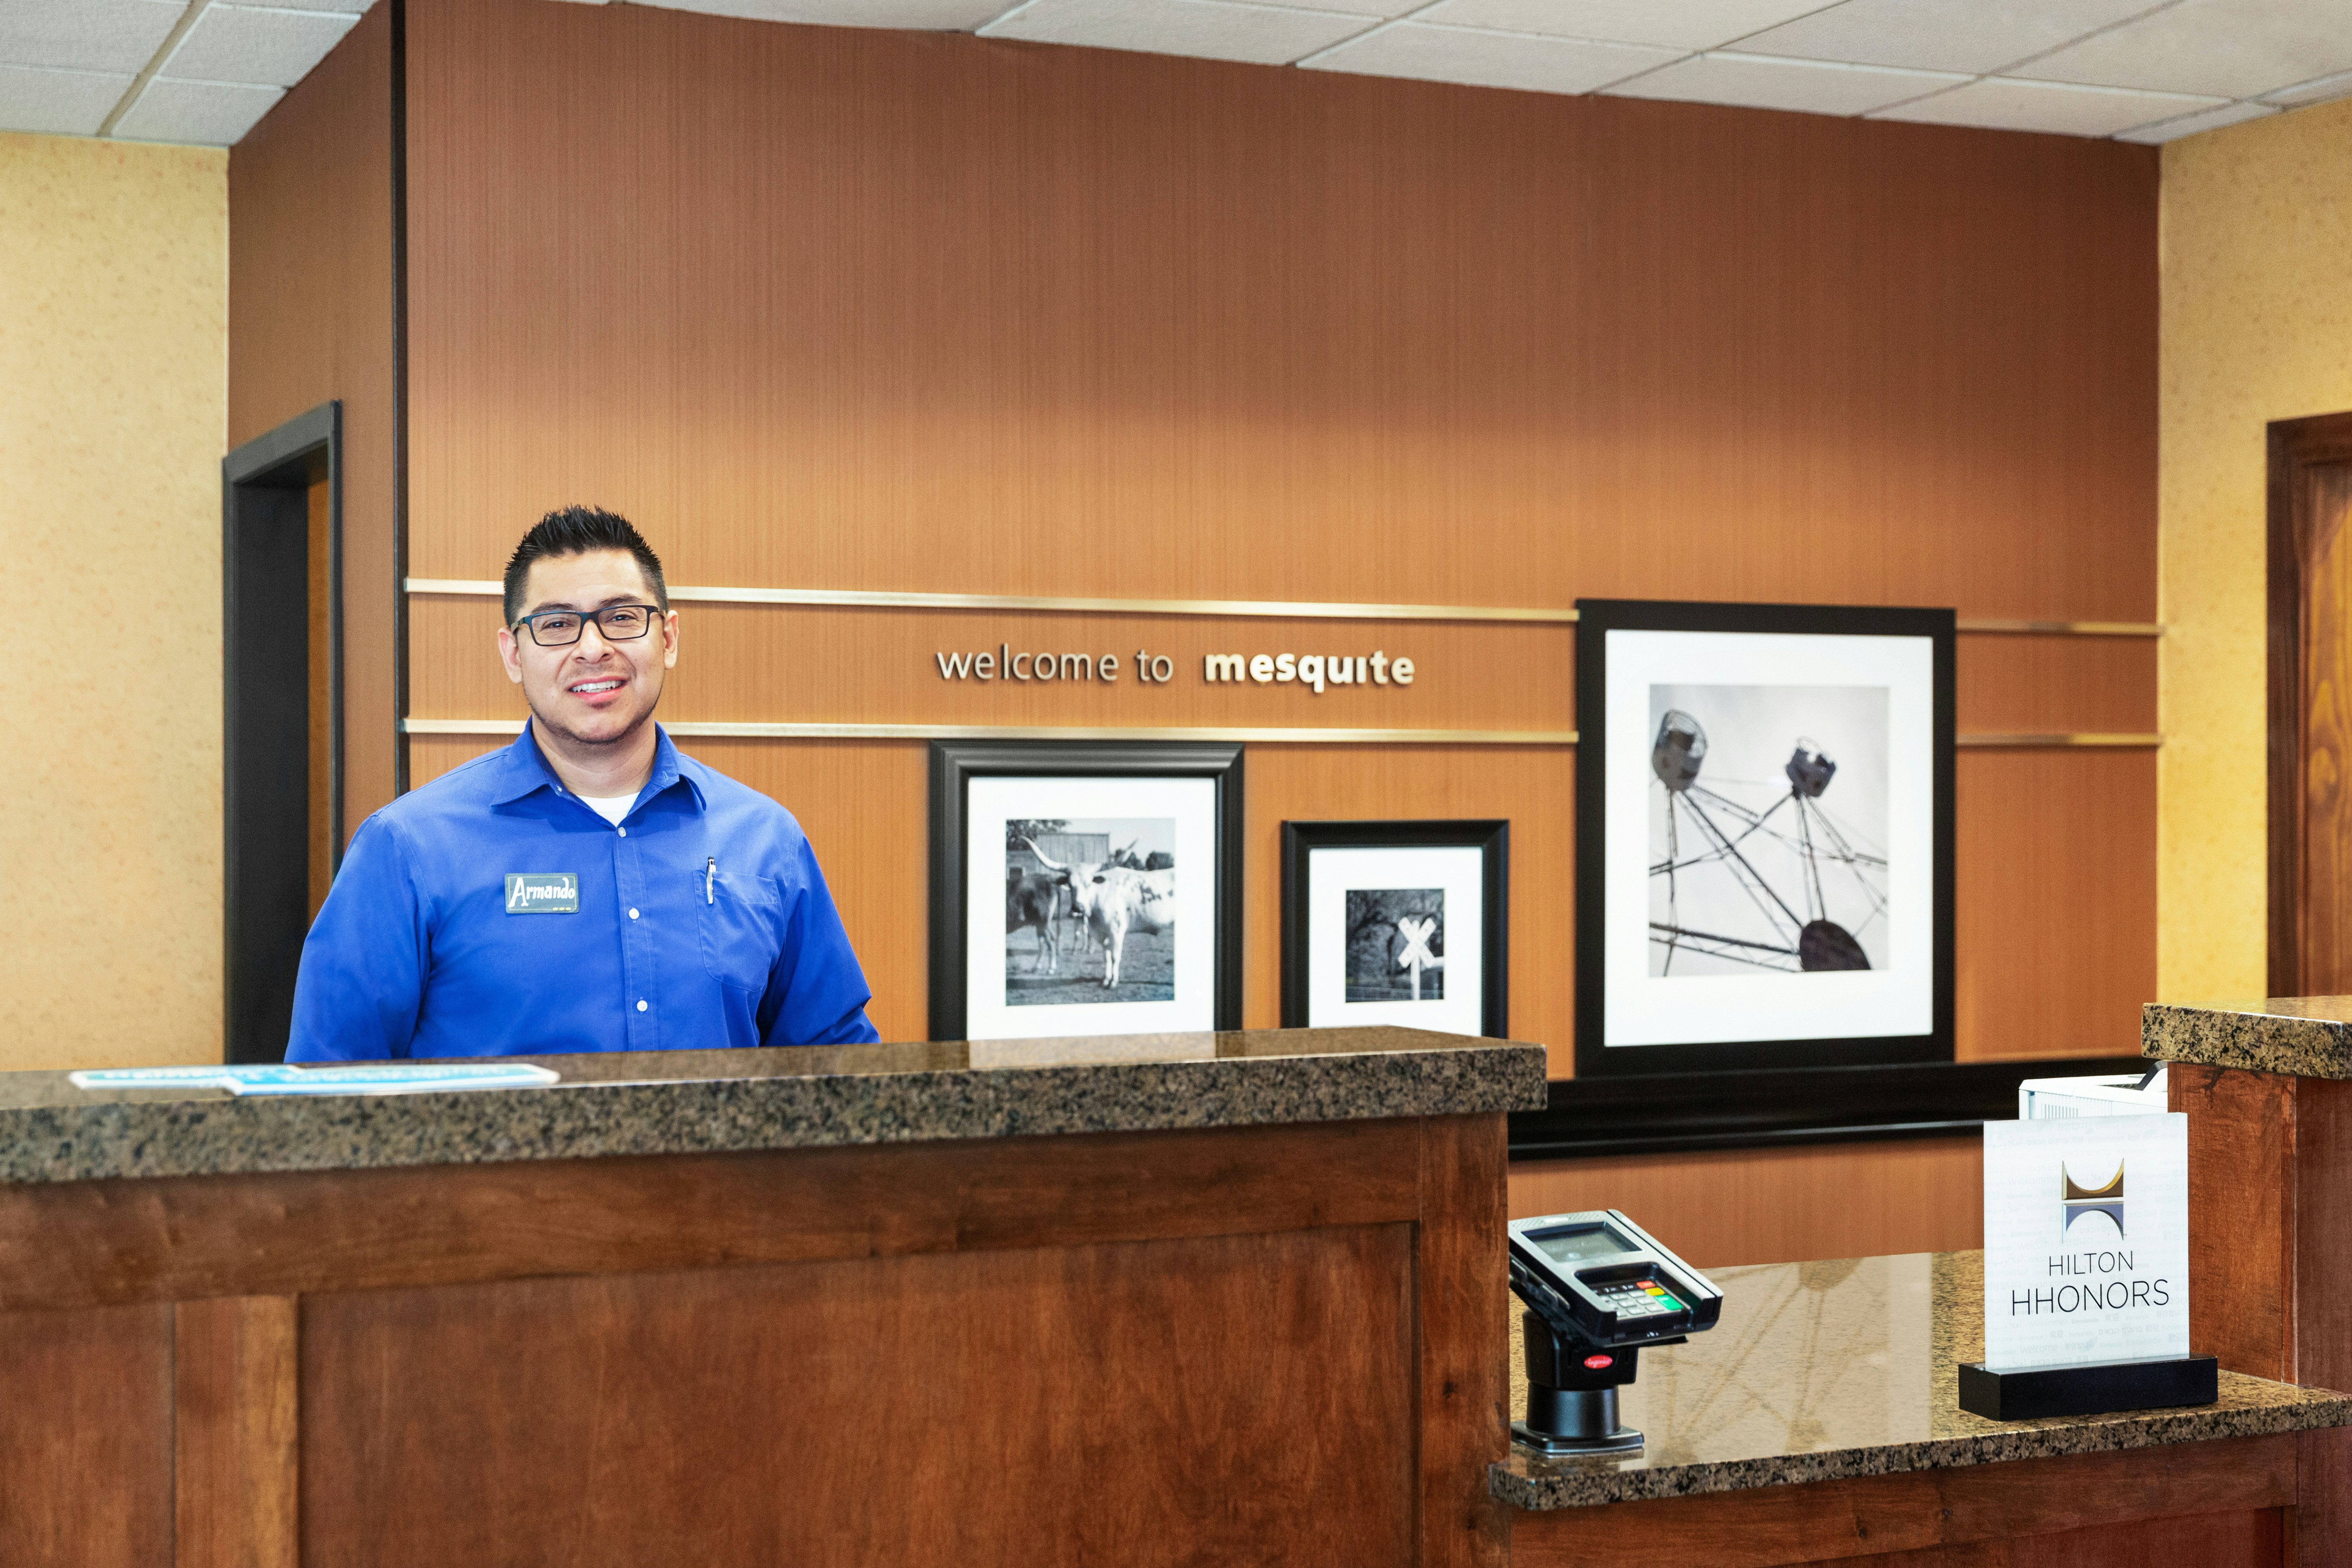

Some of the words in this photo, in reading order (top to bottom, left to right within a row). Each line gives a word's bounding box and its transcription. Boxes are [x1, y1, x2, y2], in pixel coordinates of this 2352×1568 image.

[936, 643, 1120, 681] welcome
[1135, 649, 1174, 682] to
[1204, 650, 1416, 693] mesquite
[508, 877, 575, 907] Armando
[2049, 1250, 2133, 1276] HILTON
[2012, 1279, 2169, 1316] HHONORS
[2020, 1344, 2058, 1354] Welcome
